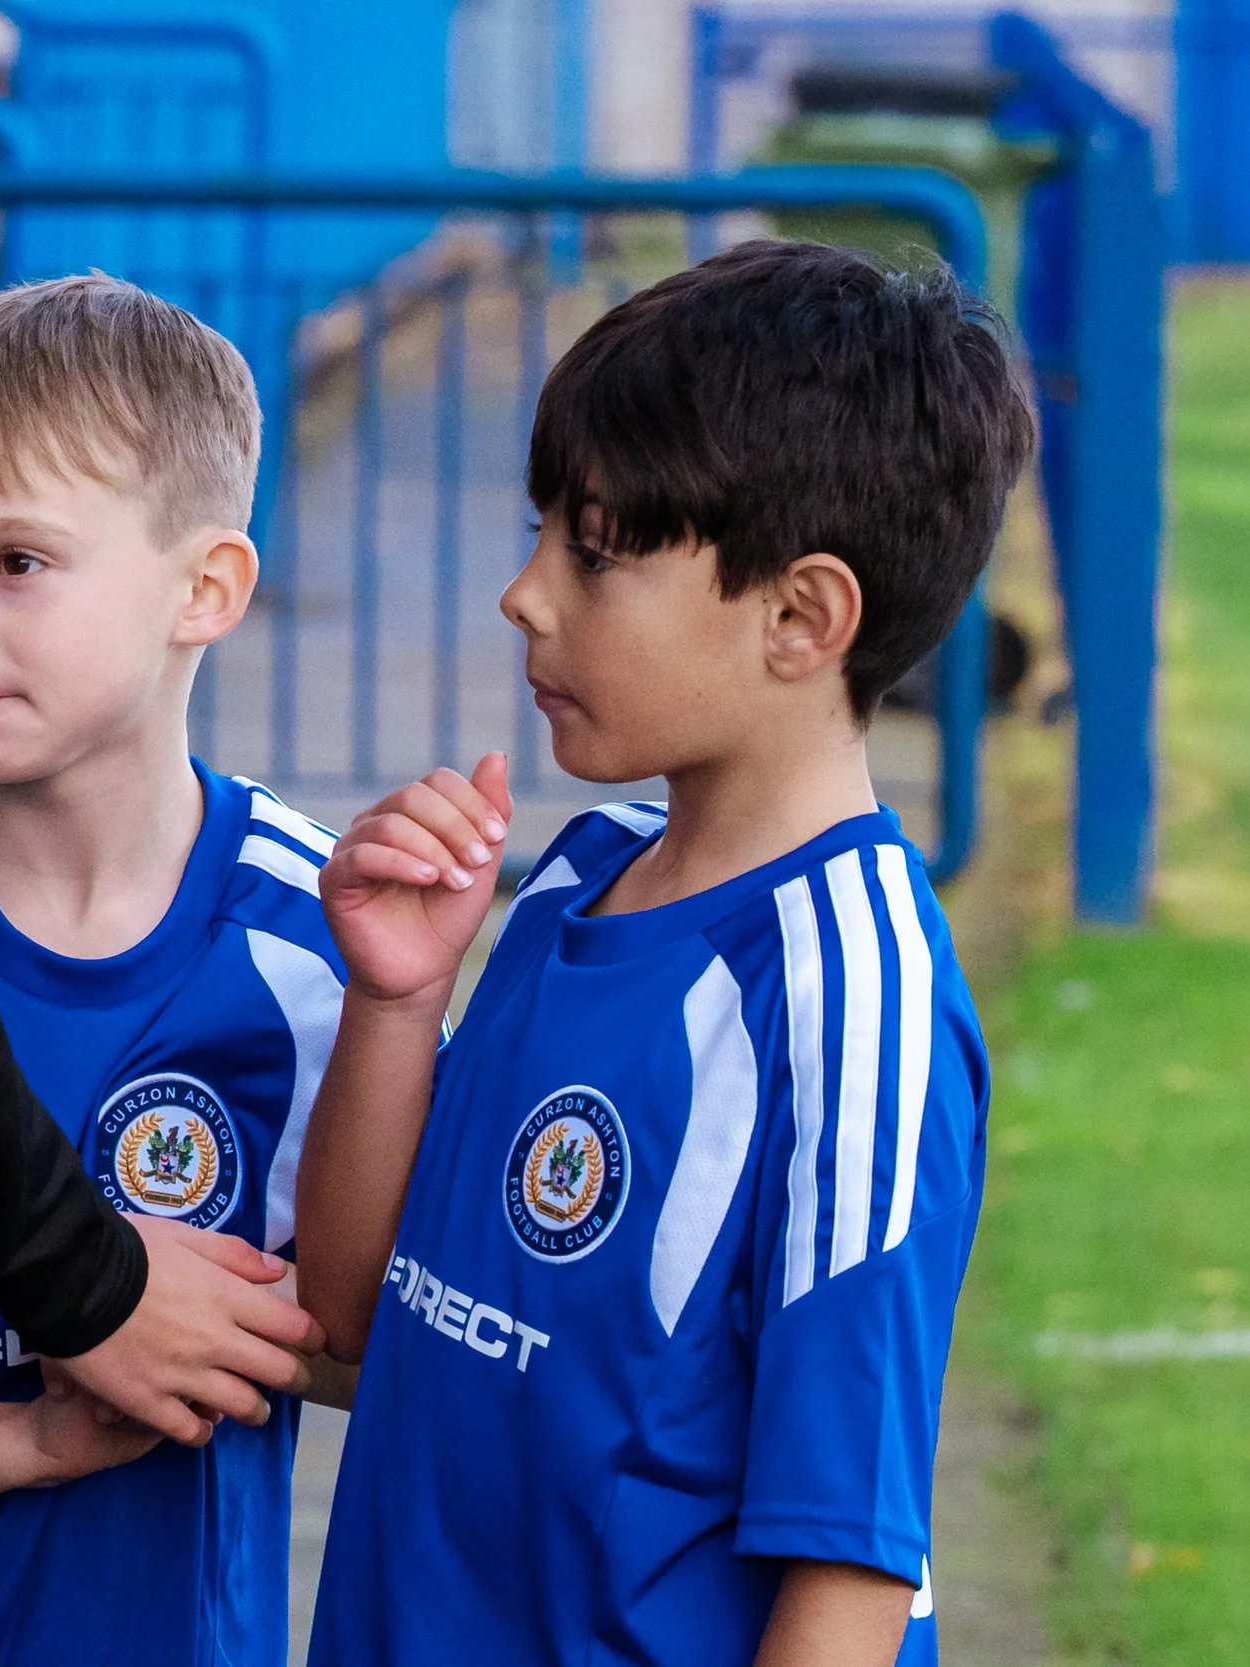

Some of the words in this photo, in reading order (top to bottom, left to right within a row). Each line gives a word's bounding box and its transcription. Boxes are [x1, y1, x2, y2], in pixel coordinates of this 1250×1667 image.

[105, 1086, 176, 1133] CURZON
[185, 1090, 233, 1155] ASHTON
[527, 1097, 585, 1137] CURZON
[588, 1105, 620, 1178] ASHTON
[189, 1192, 228, 1228] CLUB
[510, 1177, 557, 1250] FOOTBALL
[565, 1215, 603, 1248] CLUB
